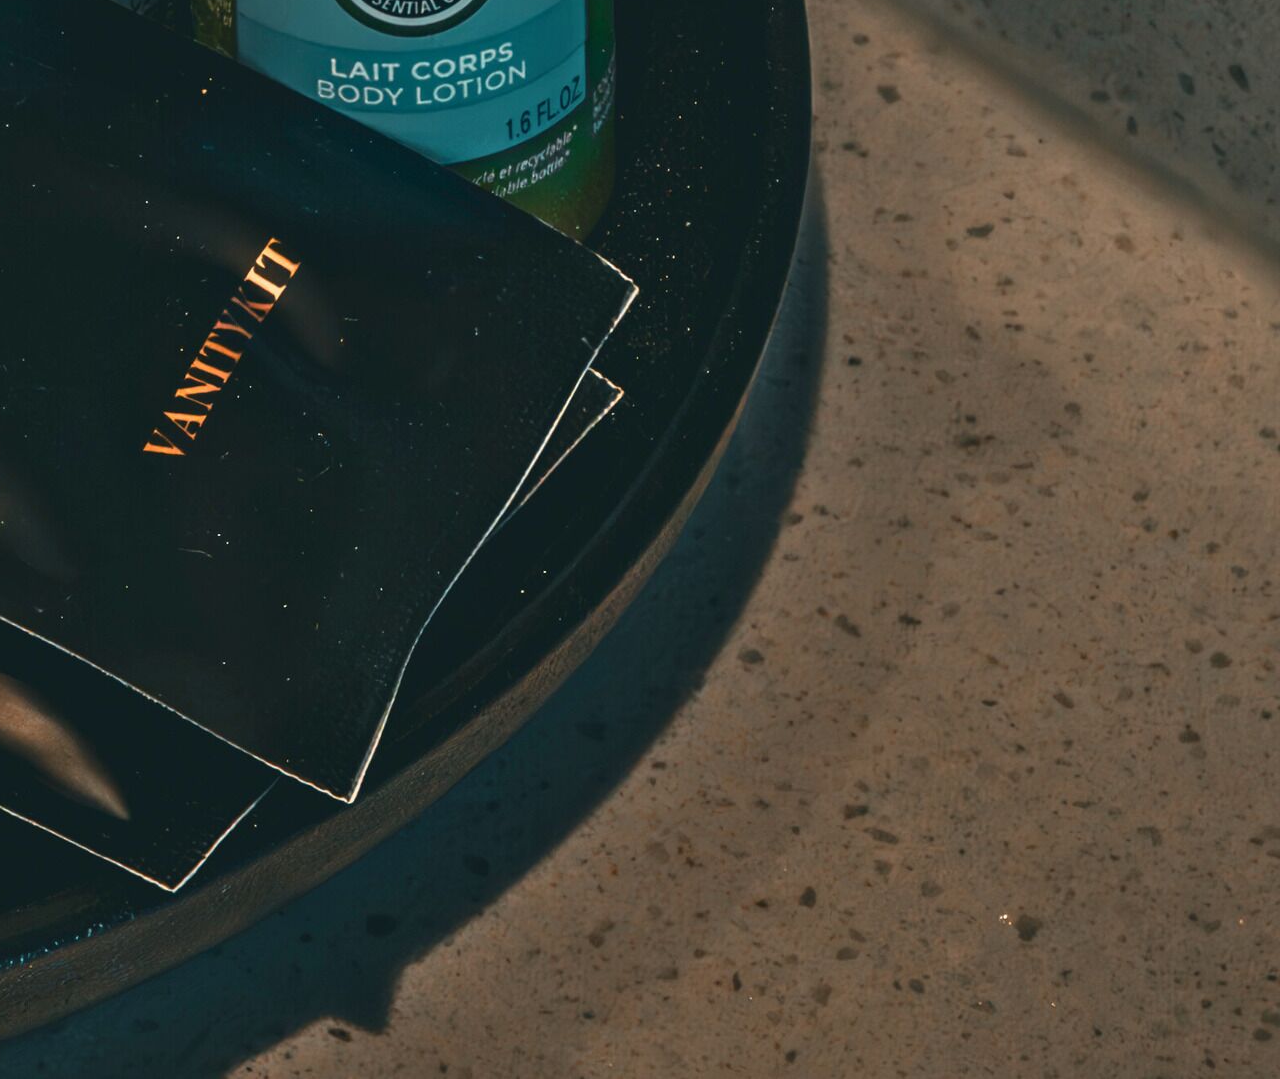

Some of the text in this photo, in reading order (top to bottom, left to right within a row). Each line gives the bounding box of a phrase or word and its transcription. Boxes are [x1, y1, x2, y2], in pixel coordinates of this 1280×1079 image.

[317, 60, 527, 106] BODY LOTION
[330, 42, 514, 82] LAIT CORPS
[505, 110, 531, 140] 1.6
[143, 237, 302, 456] VANITY KIT
